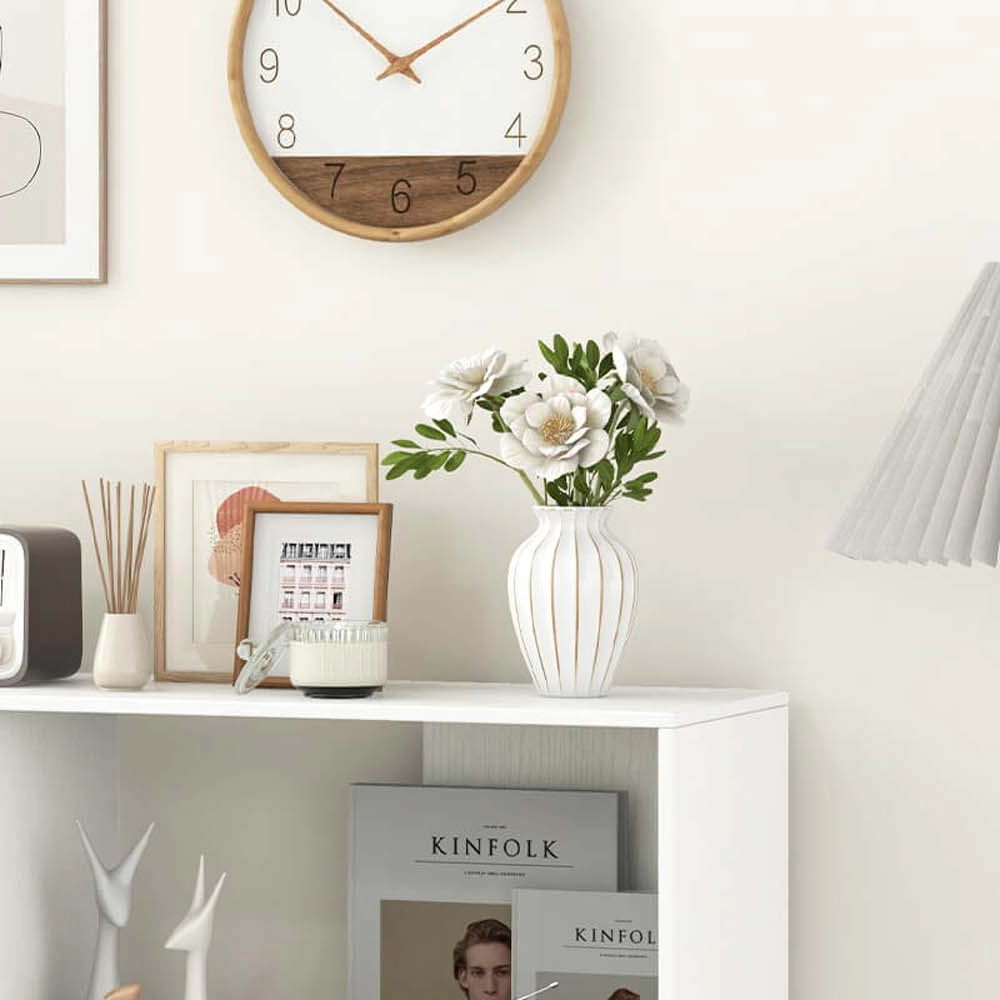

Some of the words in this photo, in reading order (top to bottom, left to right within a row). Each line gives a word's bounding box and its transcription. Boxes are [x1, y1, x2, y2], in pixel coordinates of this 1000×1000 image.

[259, 48, 279, 84] 9
[523, 44, 544, 81] 3
[276, 113, 296, 149] 8
[503, 112, 527, 148] 4
[324, 162, 346, 199] 7
[455, 160, 478, 196] 5
[390, 179, 412, 214] 6
[431, 836, 559, 859] KINFOLK
